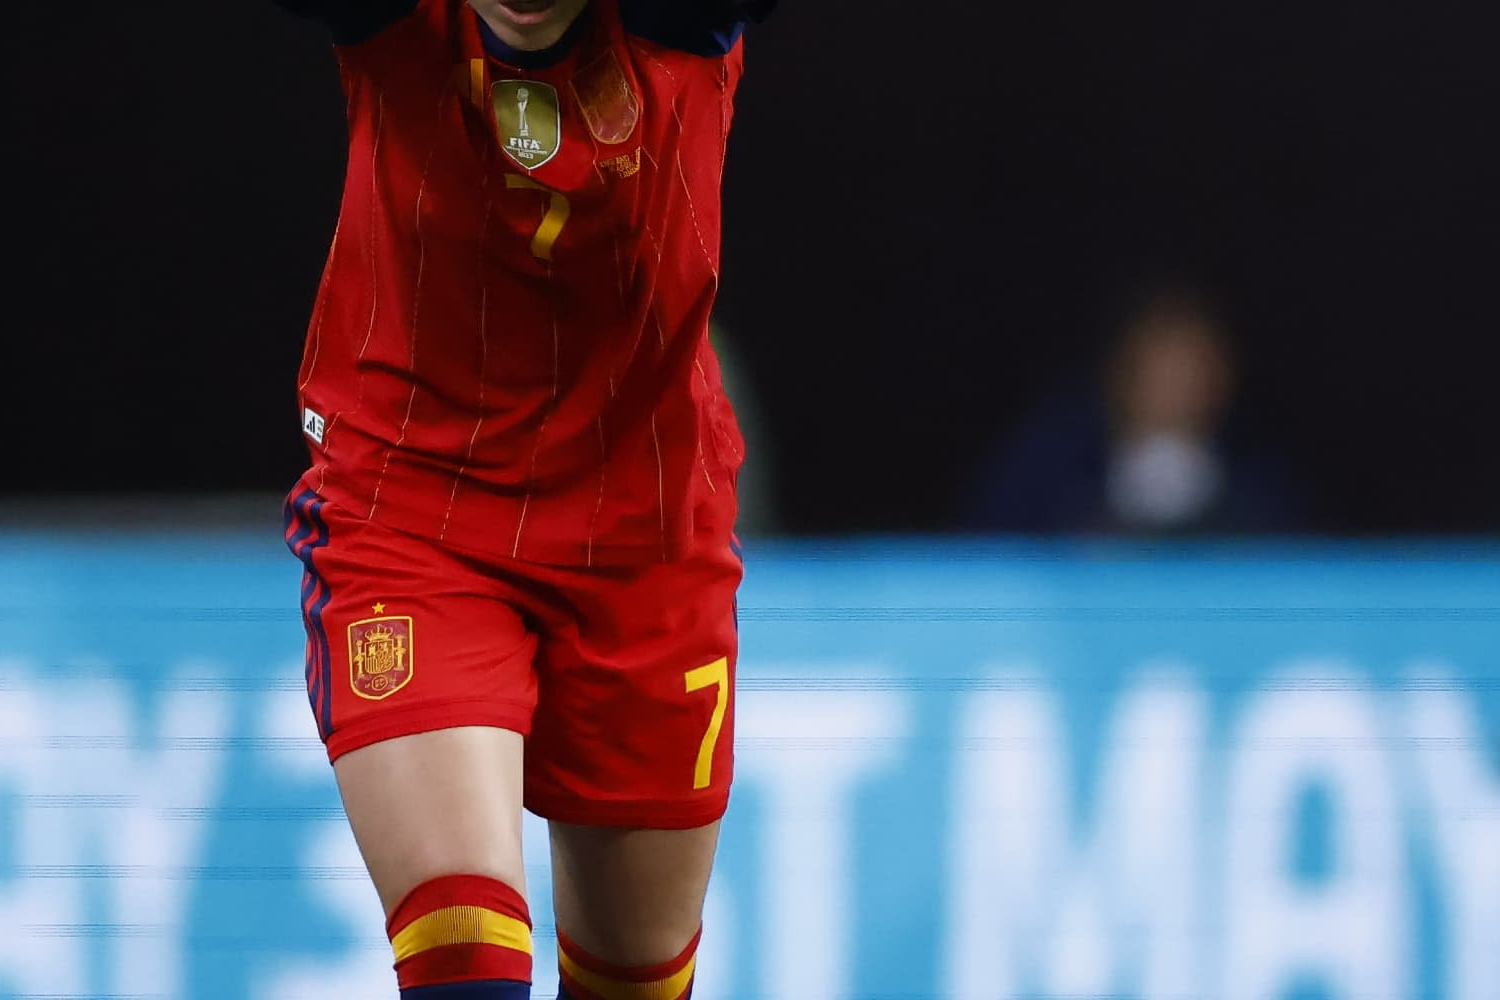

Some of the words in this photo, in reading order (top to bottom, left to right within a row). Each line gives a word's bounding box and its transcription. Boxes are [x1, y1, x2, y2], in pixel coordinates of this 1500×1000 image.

[510, 137, 541, 150] FIFA
[505, 175, 571, 260] 7
[685, 657, 728, 789] 7
